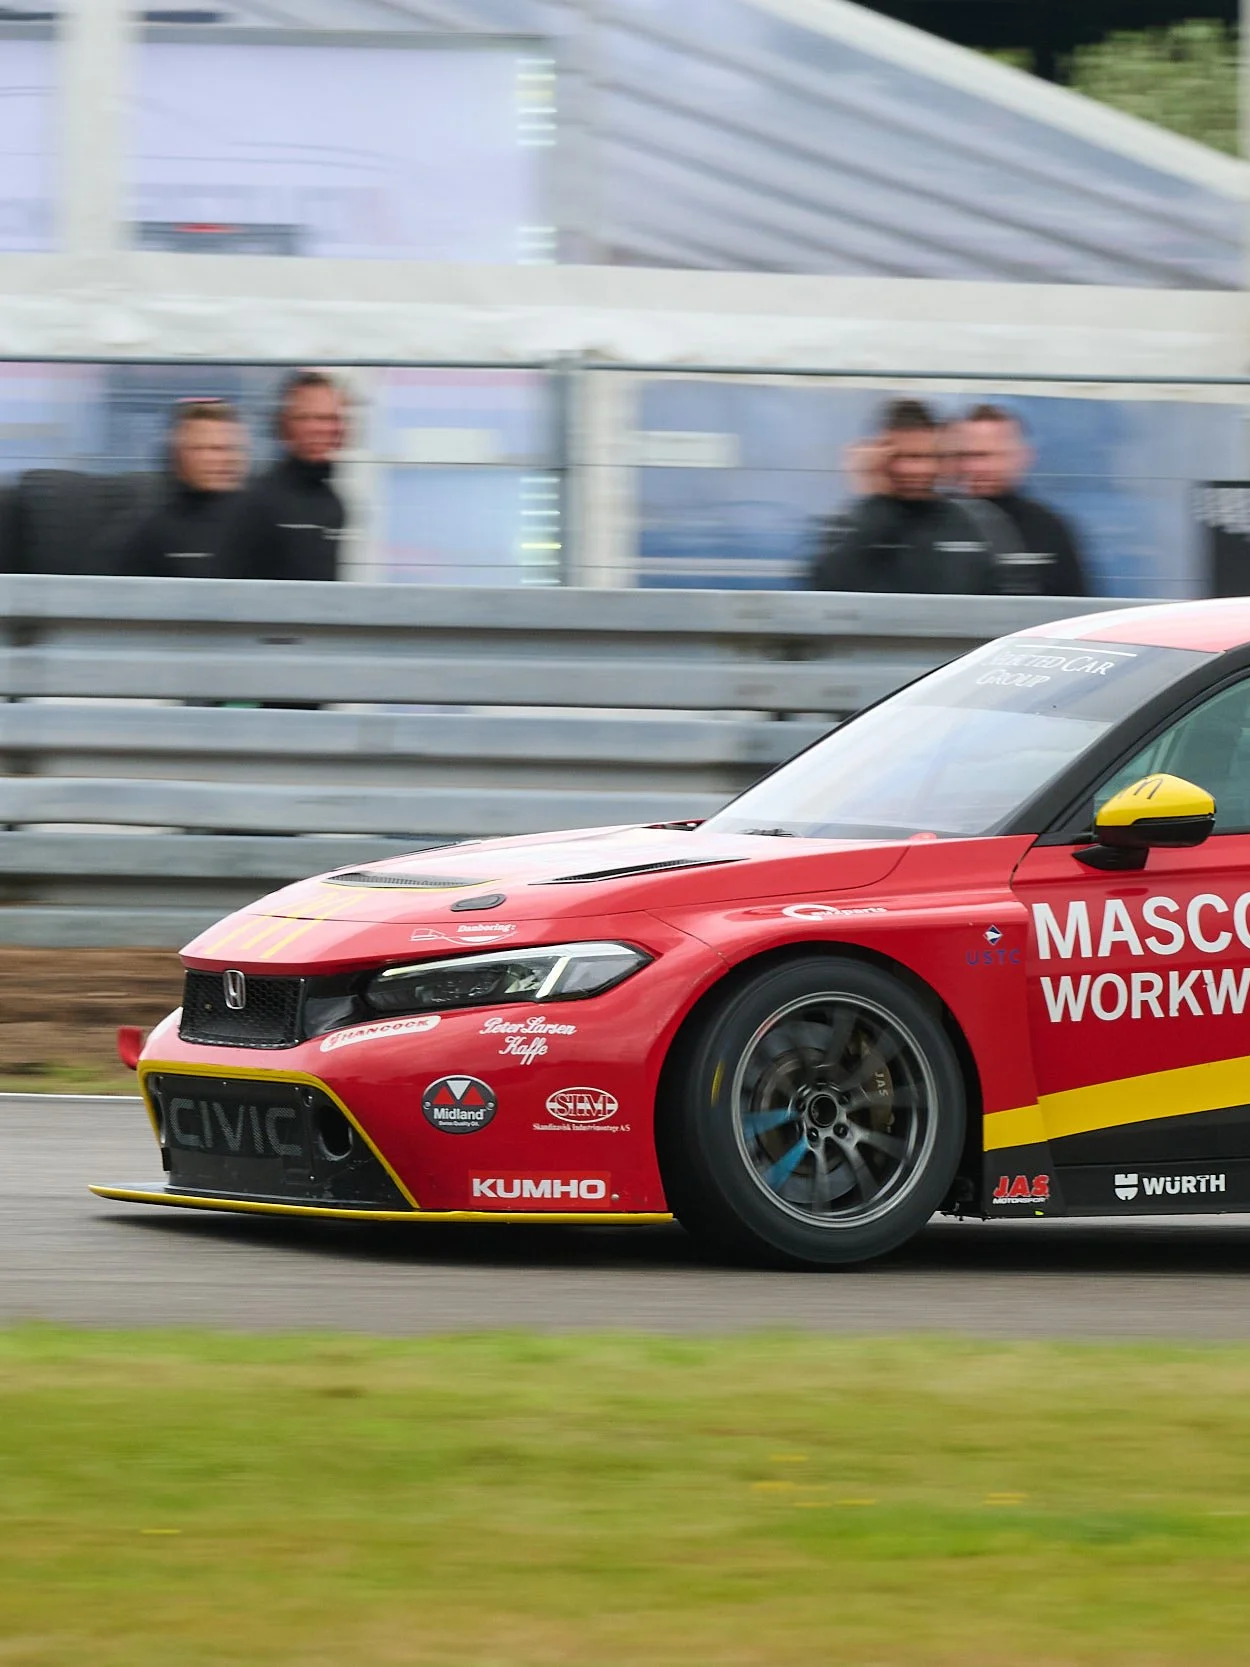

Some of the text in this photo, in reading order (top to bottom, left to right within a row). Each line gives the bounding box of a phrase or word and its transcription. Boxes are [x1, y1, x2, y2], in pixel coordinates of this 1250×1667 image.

[1061, 656, 1115, 675] CAR
[976, 669, 1050, 687] GROUP
[480, 1016, 577, 1036] Peter Larsen
[498, 1035, 549, 1065] Kaffe
[433, 1107, 485, 1120] Midland
[169, 1097, 302, 1156] CIVIC
[472, 1178, 606, 1199] KUMHO
[993, 1174, 1050, 1198] JAS
